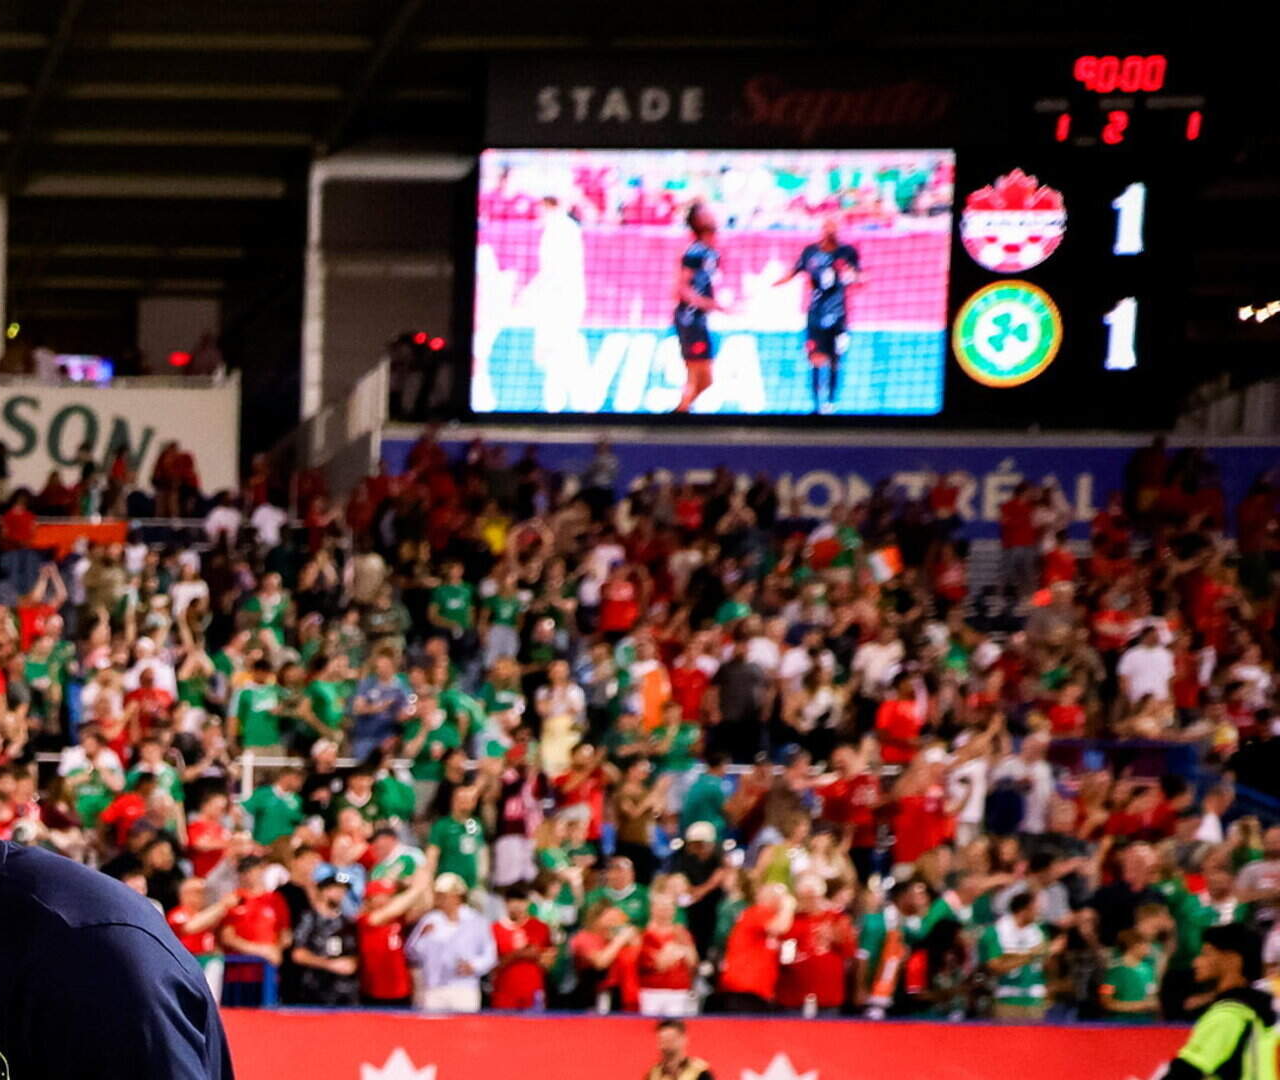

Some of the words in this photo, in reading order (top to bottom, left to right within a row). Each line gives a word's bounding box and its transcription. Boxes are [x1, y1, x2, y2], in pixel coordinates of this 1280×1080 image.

[536, 85, 705, 123] STADE
[1112, 182, 1146, 255] 1
[1103, 296, 1138, 370] 1
